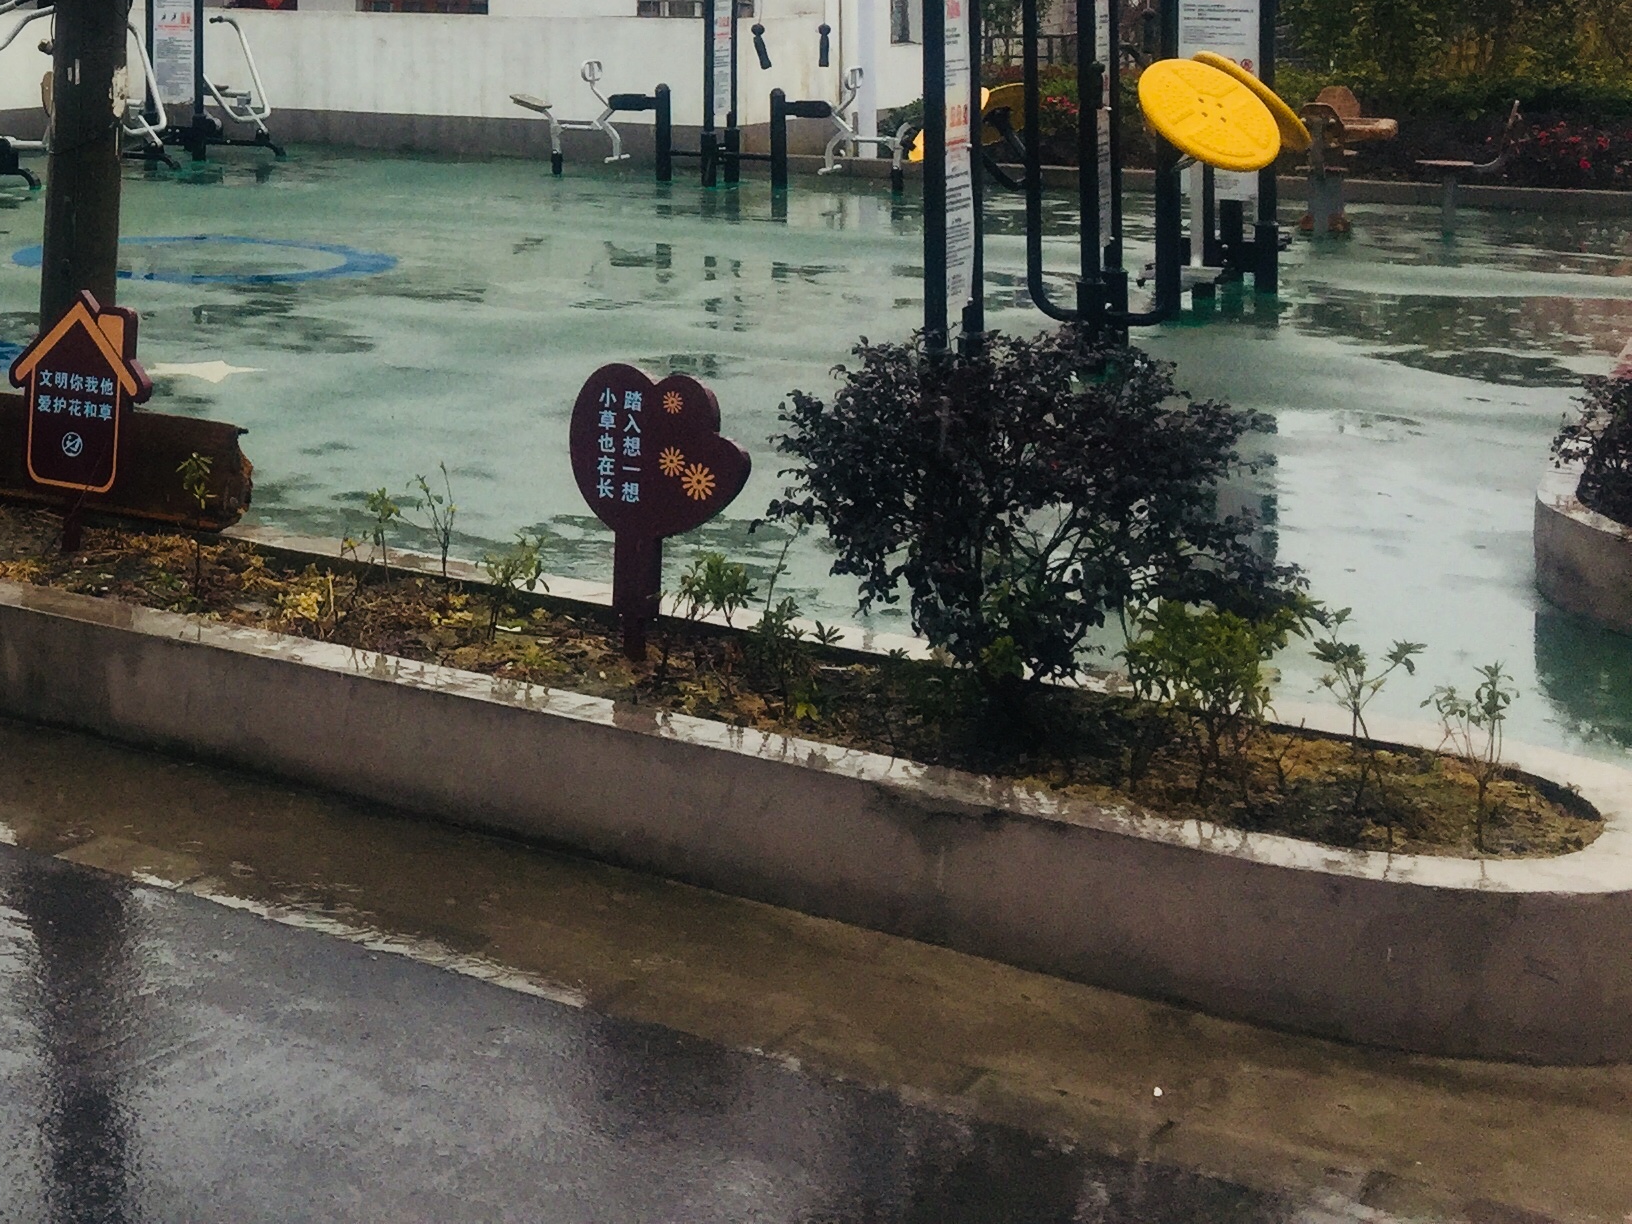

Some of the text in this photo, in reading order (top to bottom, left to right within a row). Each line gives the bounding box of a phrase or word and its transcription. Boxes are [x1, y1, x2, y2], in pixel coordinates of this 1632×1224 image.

[37, 394, 113, 421] 爱护花和草
[39, 369, 114, 396] 文明你我他
[596, 388, 617, 499] 小草也在长
[621, 390, 643, 503] 踏入想一想
